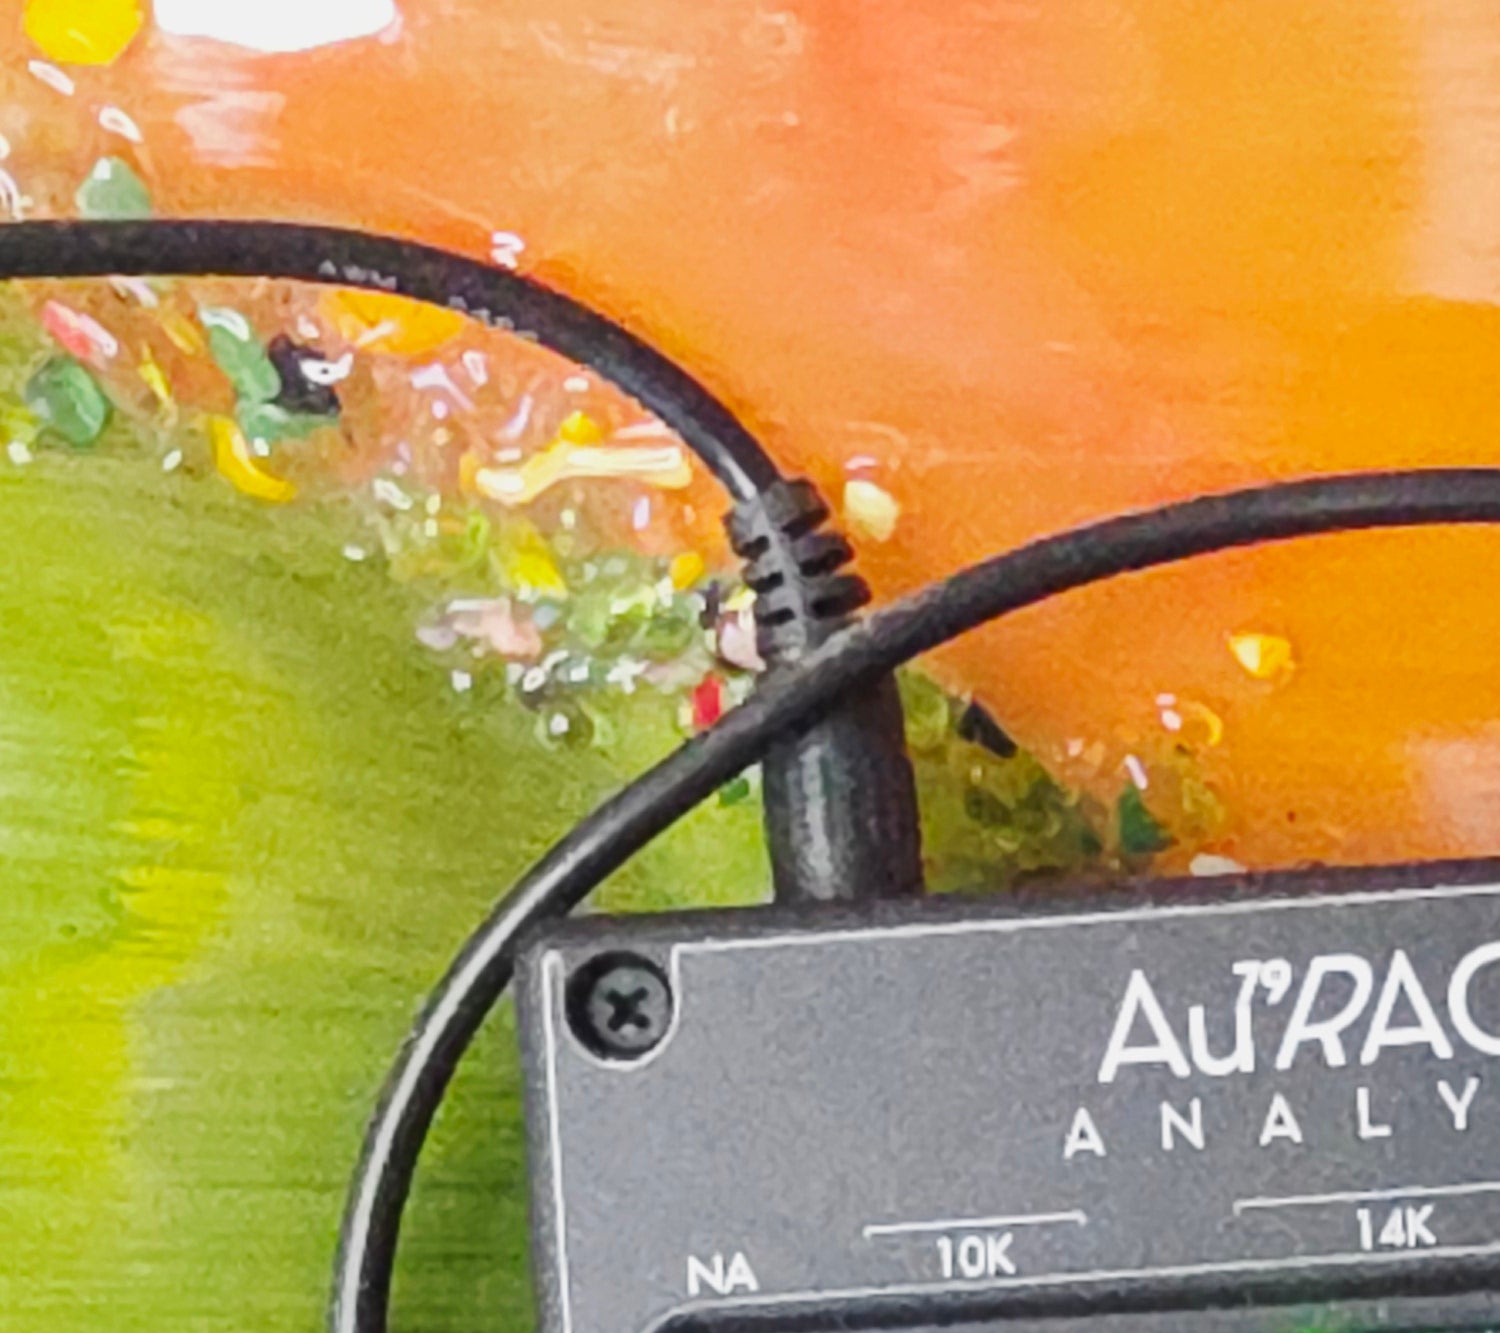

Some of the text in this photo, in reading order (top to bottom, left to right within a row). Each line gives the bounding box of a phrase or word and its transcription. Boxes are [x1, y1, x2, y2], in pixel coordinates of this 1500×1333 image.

[687, 1251, 760, 1295] NA
[937, 1232, 1017, 1279] 10K
[1356, 1204, 1438, 1251] 14K
